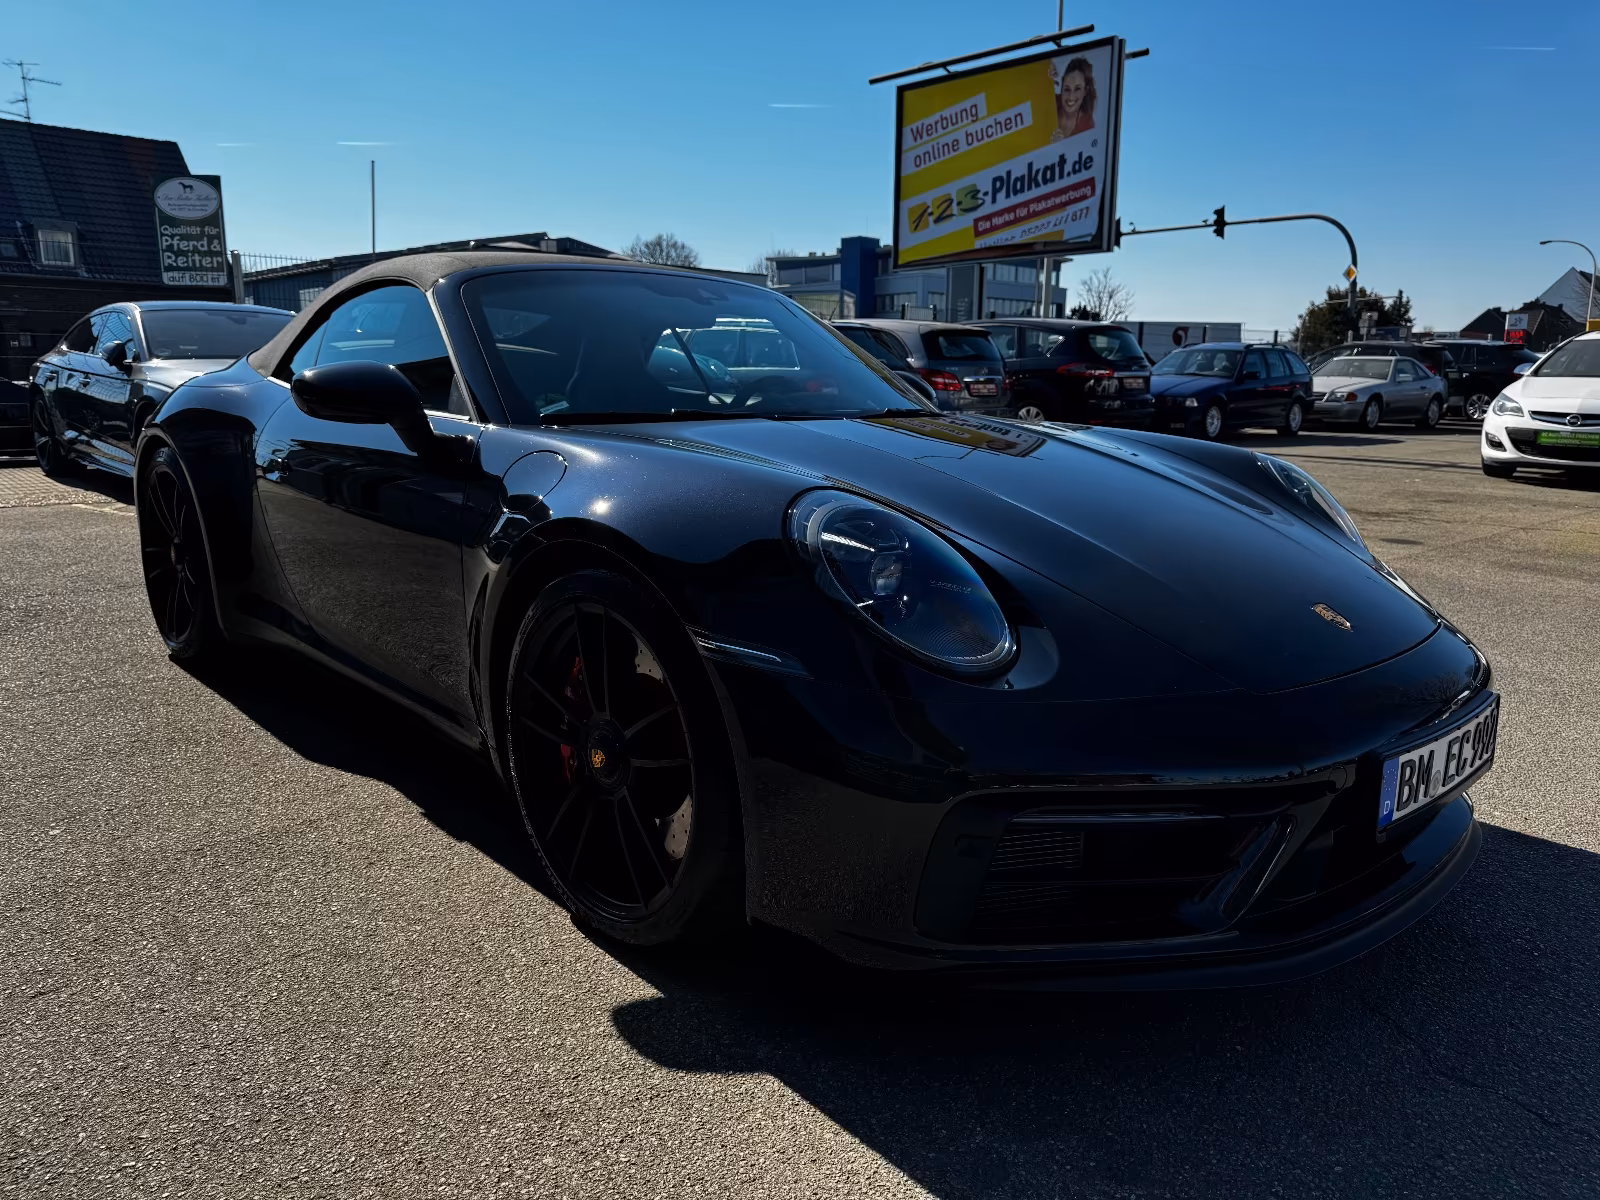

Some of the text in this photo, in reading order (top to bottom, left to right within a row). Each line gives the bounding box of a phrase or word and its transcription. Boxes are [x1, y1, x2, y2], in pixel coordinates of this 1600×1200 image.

[910, 103, 979, 143] Werbung
[914, 112, 1024, 168] online buchen
[978, 186, 1092, 232] Die Marke für Plakatwerbung
[161, 225, 220, 236] Qualität für
[161, 236, 221, 252] Pferd &
[163, 252, 222, 268] Reiter
[168, 273, 186, 283] auf
[1396, 750, 1434, 812] BM
